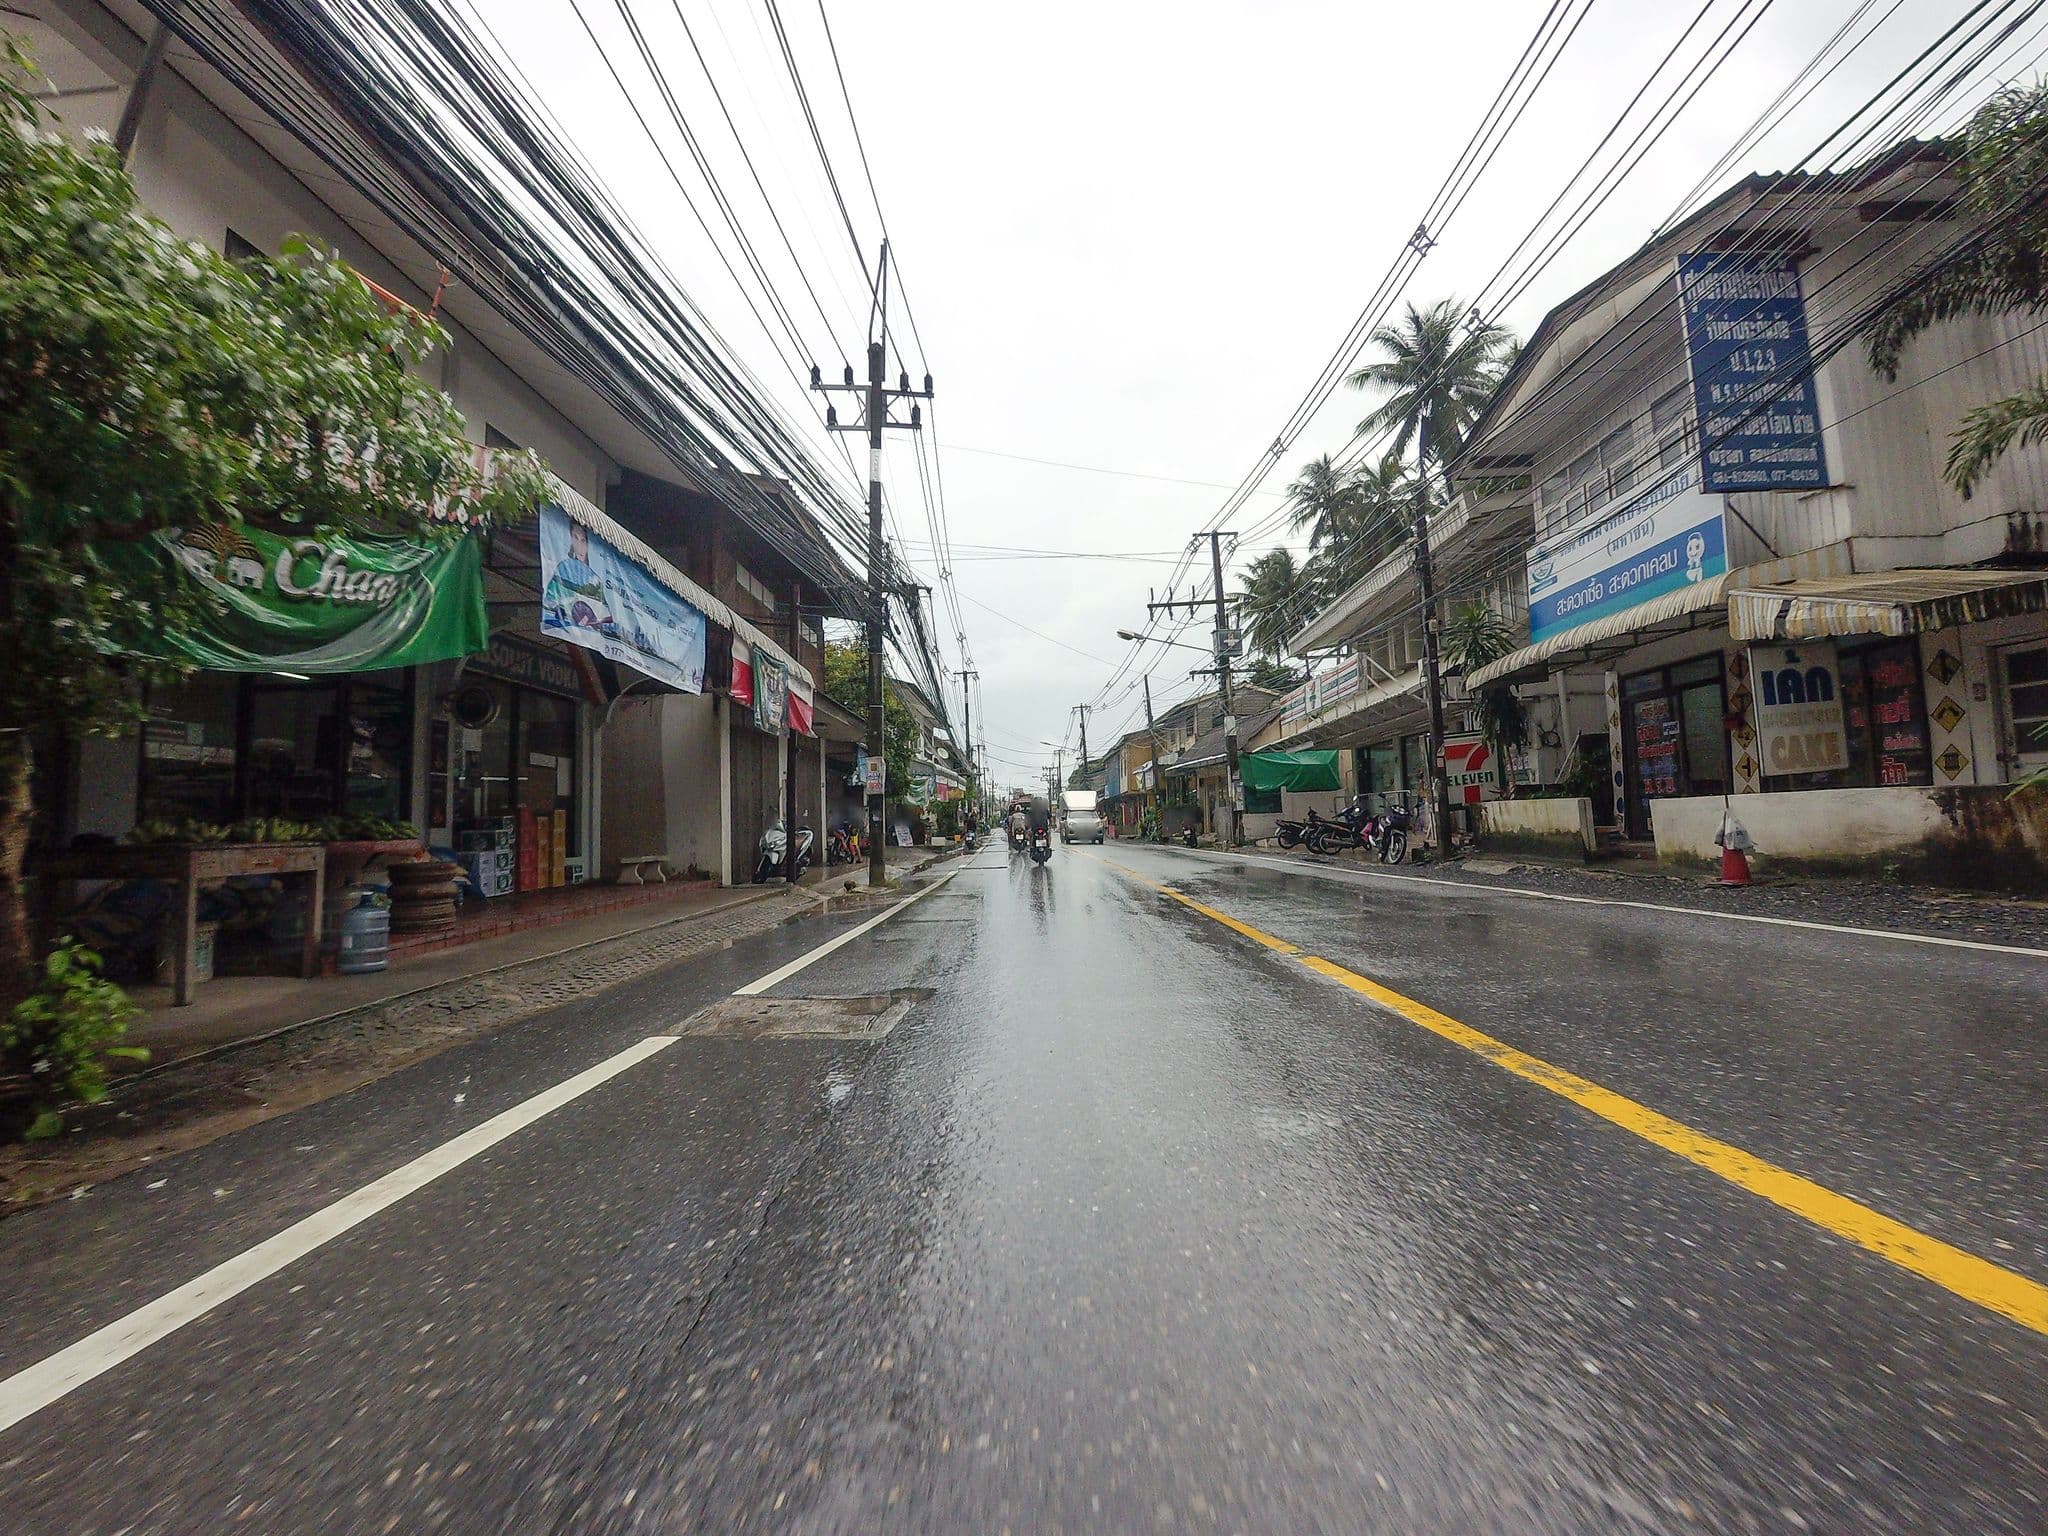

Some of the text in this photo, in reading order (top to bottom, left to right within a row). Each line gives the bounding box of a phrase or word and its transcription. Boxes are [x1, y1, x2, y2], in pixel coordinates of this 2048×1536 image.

[1606, 518, 1655, 558] (มหาชน)
[1556, 548, 1679, 616] สะดวกซื้อ สะดวกเคลม
[1770, 732, 1841, 771] CAKE
